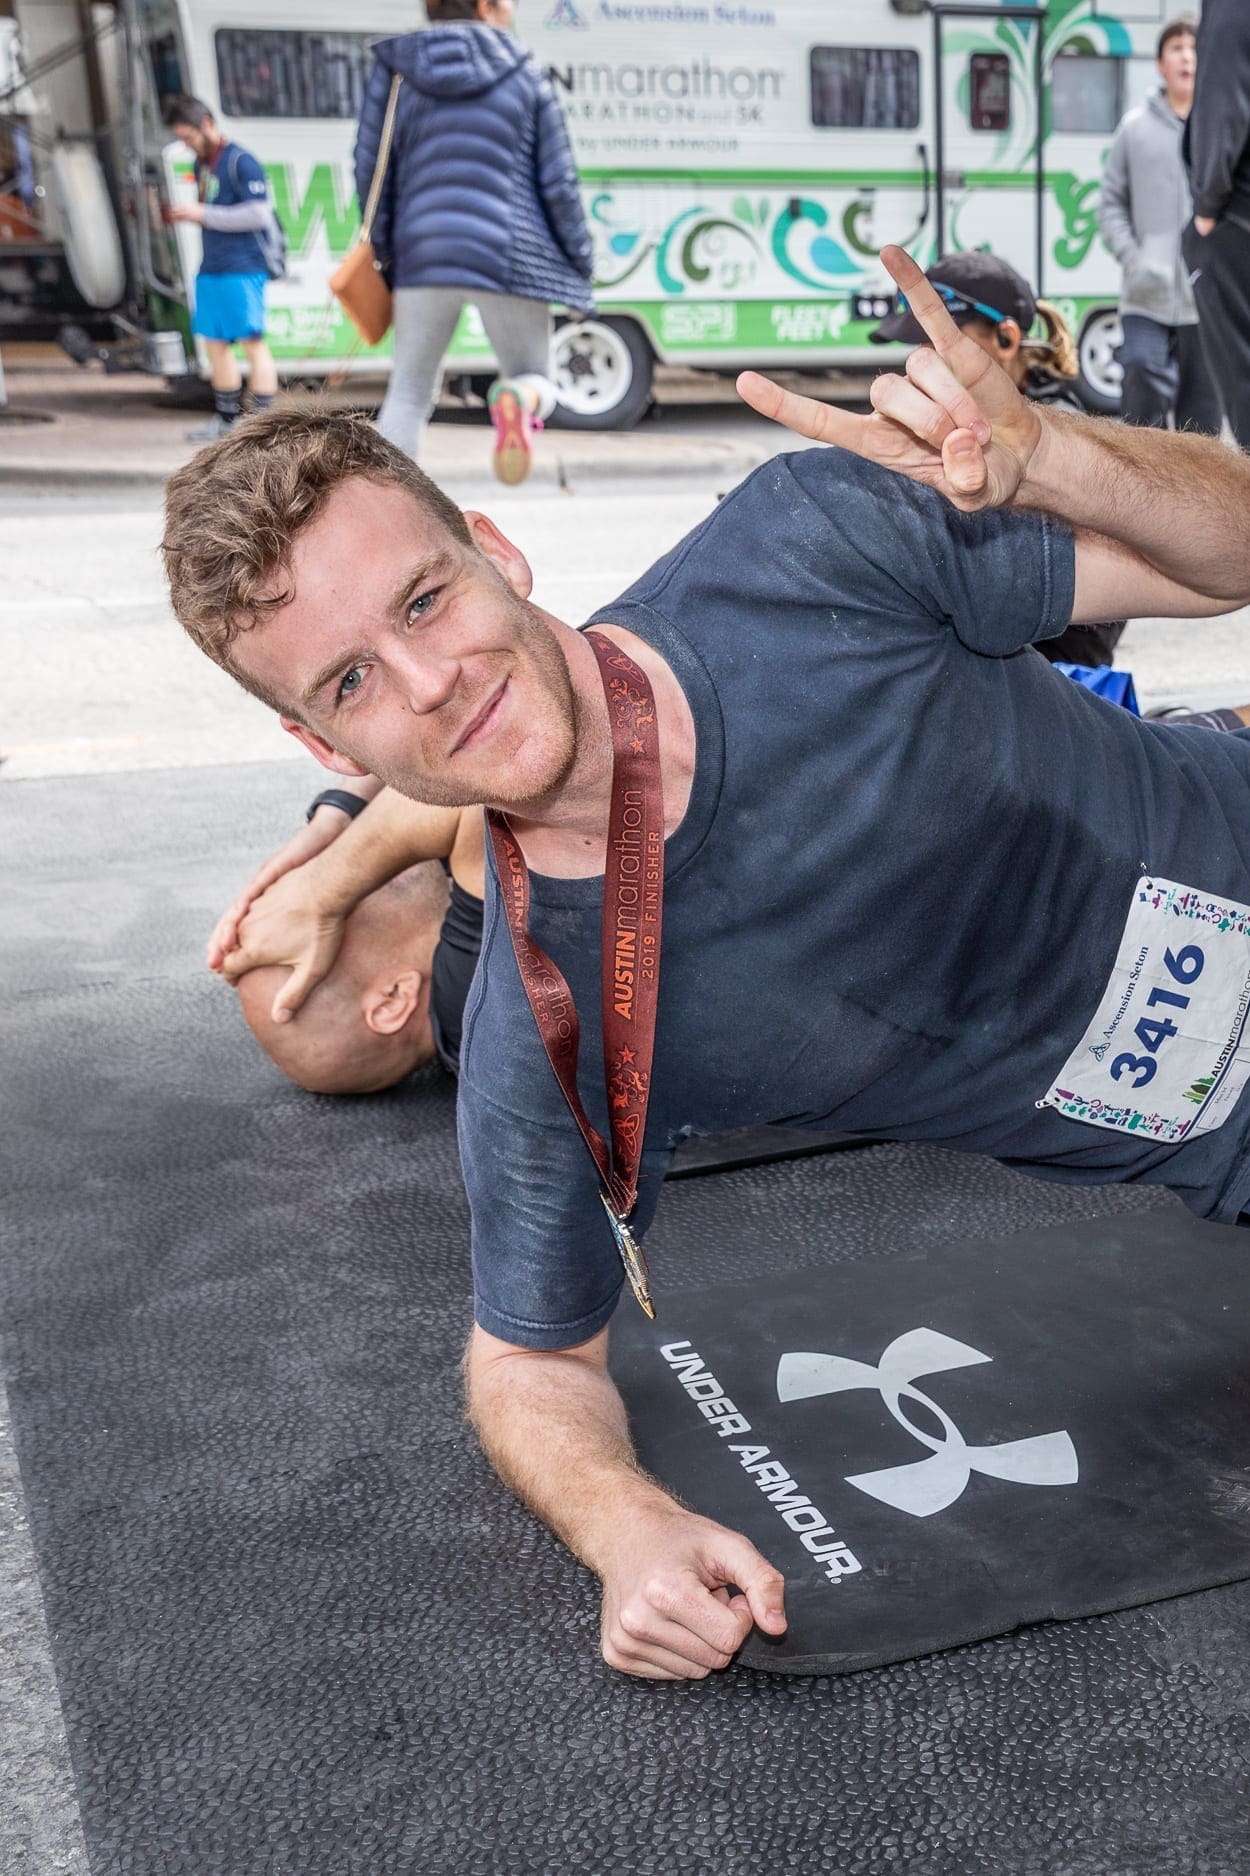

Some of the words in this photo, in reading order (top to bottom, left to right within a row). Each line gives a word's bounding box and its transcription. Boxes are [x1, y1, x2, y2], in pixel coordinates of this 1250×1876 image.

[547, 54, 783, 99] Nmarathon
[565, 101, 696, 124] ARATHON
[613, 789, 642, 1020] AUSTINmarathon
[645, 831, 660, 922] FINISHER
[642, 935, 656, 979] 2019
[1102, 981, 1135, 1039] Ascension
[1129, 946, 1149, 982] Seton
[1110, 944, 1205, 1089] 3416
[659, 1340, 751, 1438] UNDER
[728, 1444, 862, 1580] ARMOUR
